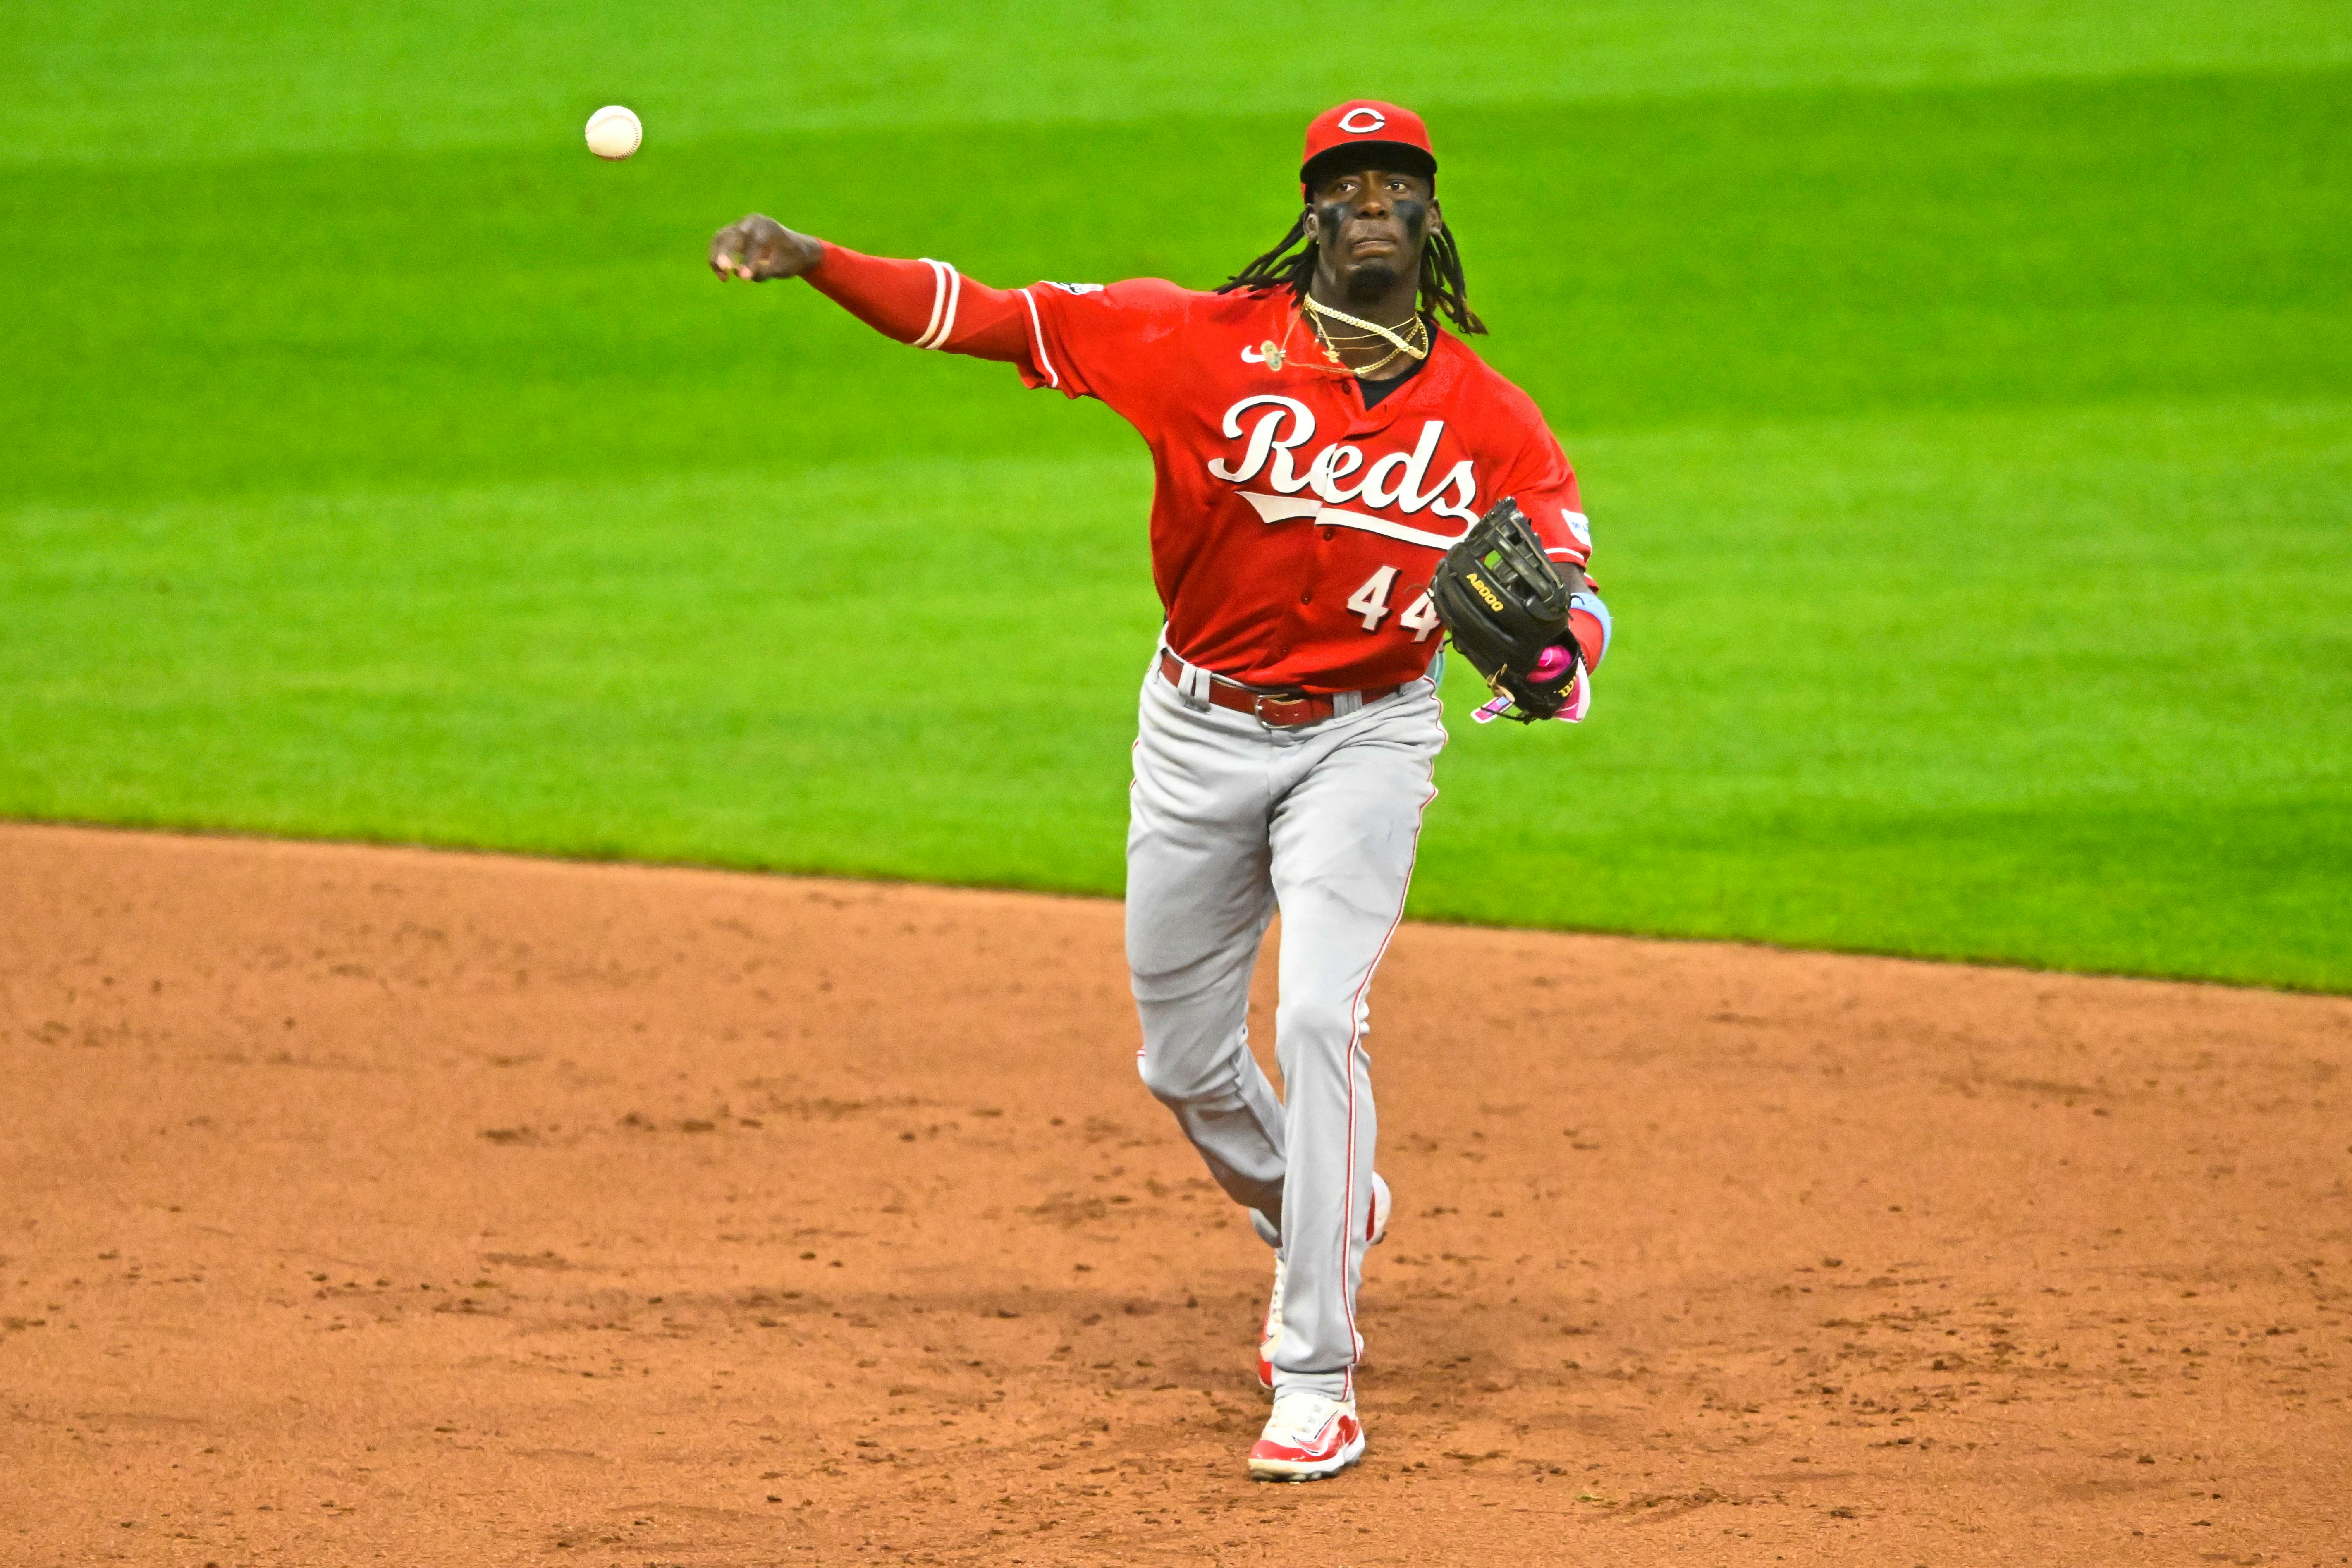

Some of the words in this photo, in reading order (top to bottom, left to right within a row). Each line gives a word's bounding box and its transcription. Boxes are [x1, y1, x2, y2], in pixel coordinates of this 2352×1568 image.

[1337, 108, 1385, 134] C
[1208, 394, 1478, 522] Reds
[1346, 564, 1441, 644] 44
[1466, 573, 1504, 612] A2000
